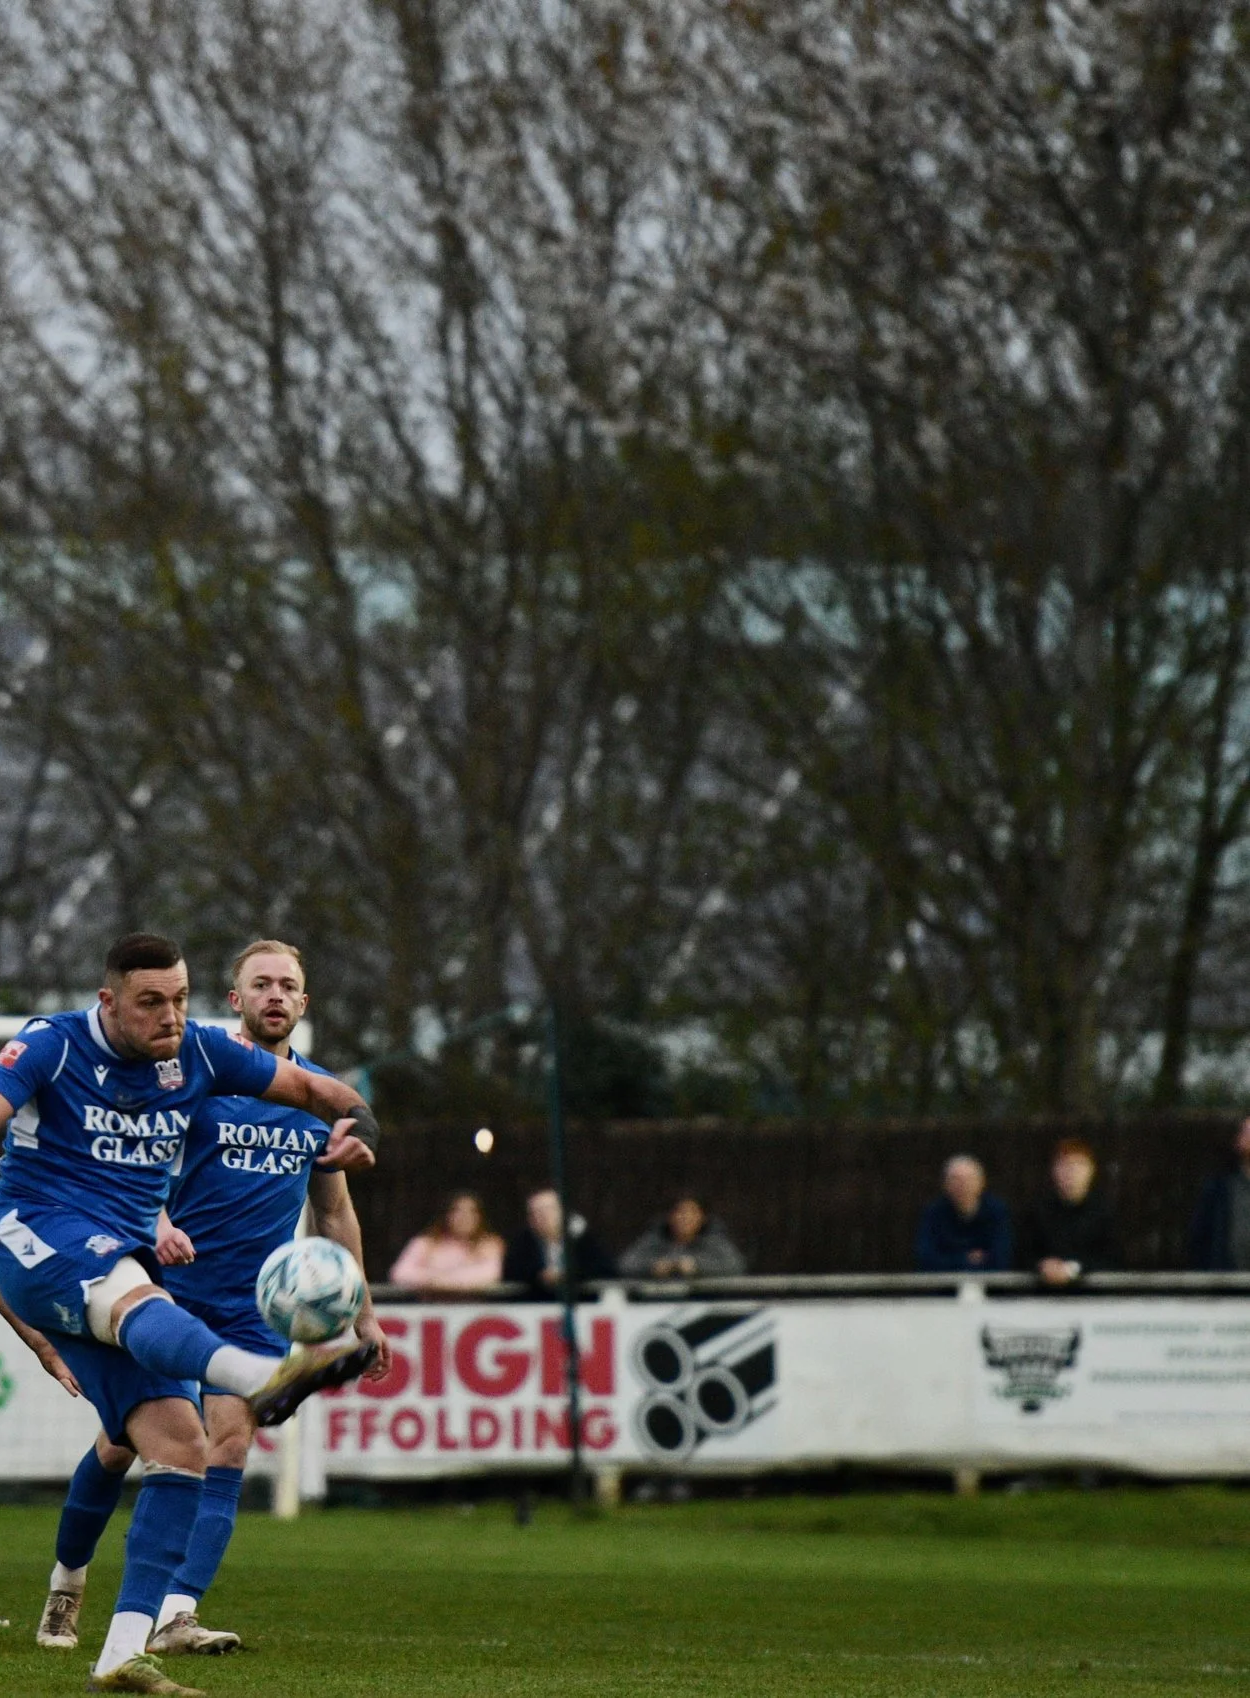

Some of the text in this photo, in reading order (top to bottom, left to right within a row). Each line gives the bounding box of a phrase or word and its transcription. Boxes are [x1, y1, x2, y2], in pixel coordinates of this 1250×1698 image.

[83, 1105, 191, 1138] ROMAN
[217, 1122, 319, 1153] ROMAN
[91, 1136, 181, 1166] GLASS
[222, 1148, 308, 1175] GLASS
[320, 1316, 616, 1399] SIGN
[255, 1405, 618, 1453] FFOLDING
